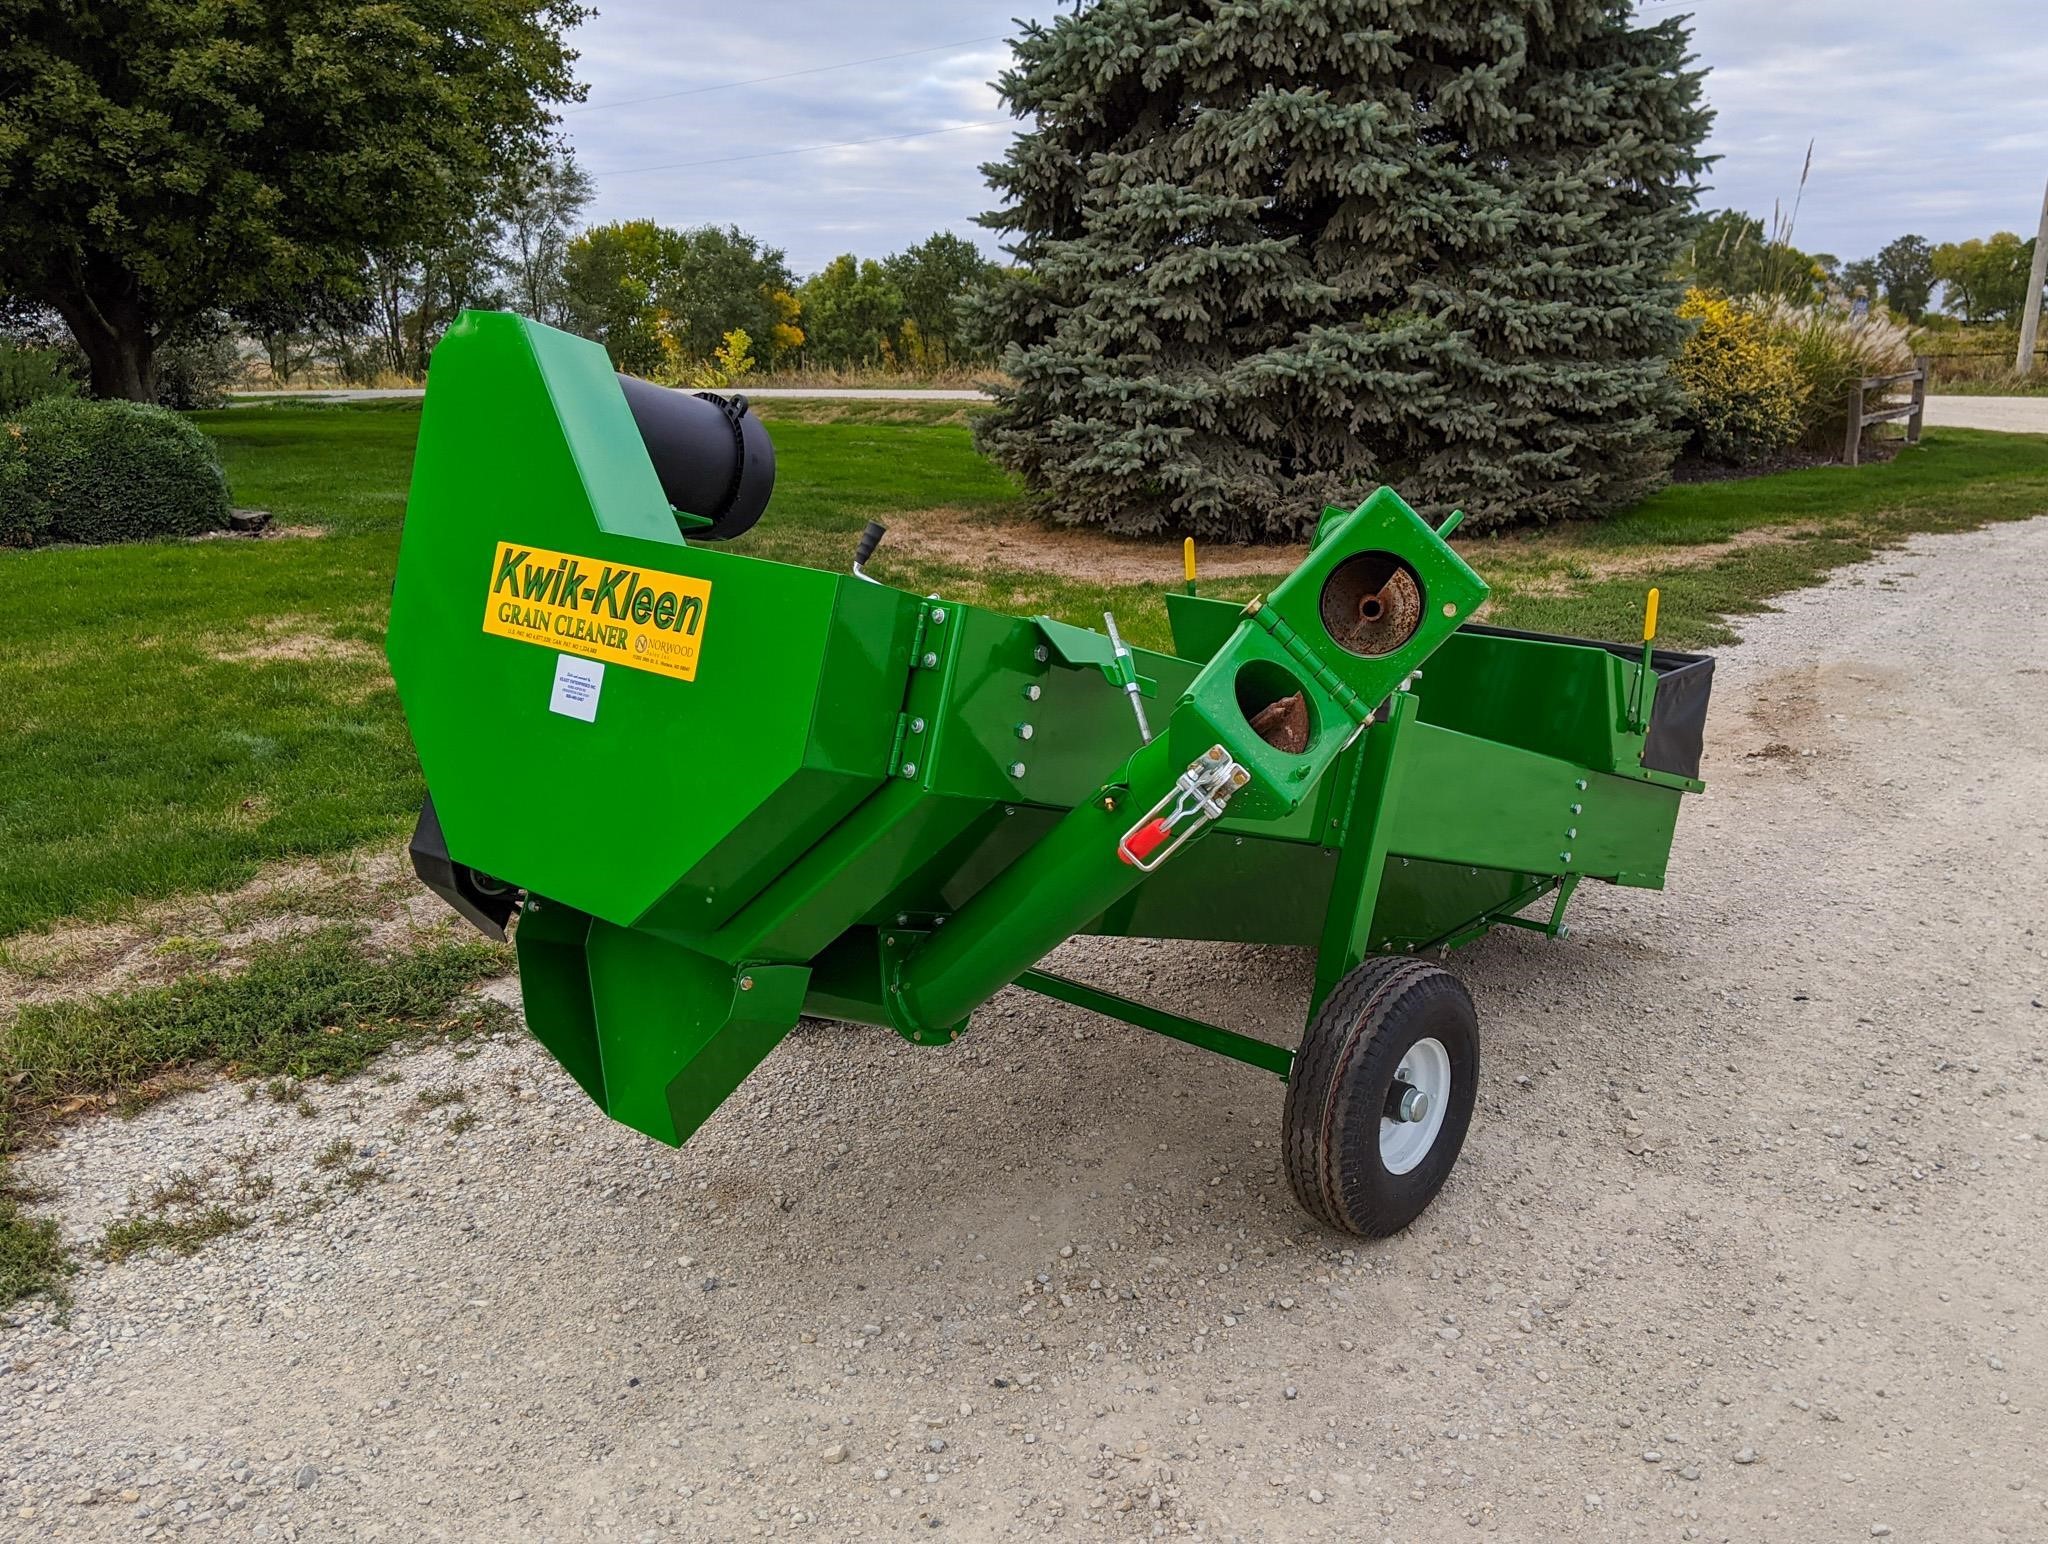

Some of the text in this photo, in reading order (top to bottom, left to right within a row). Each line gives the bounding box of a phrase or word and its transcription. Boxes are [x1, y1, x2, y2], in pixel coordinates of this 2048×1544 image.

[493, 548, 703, 635] Kwik-Kleen
[498, 602, 629, 651] GRAIN CLEANER
[648, 638, 694, 657] NORWOOD
